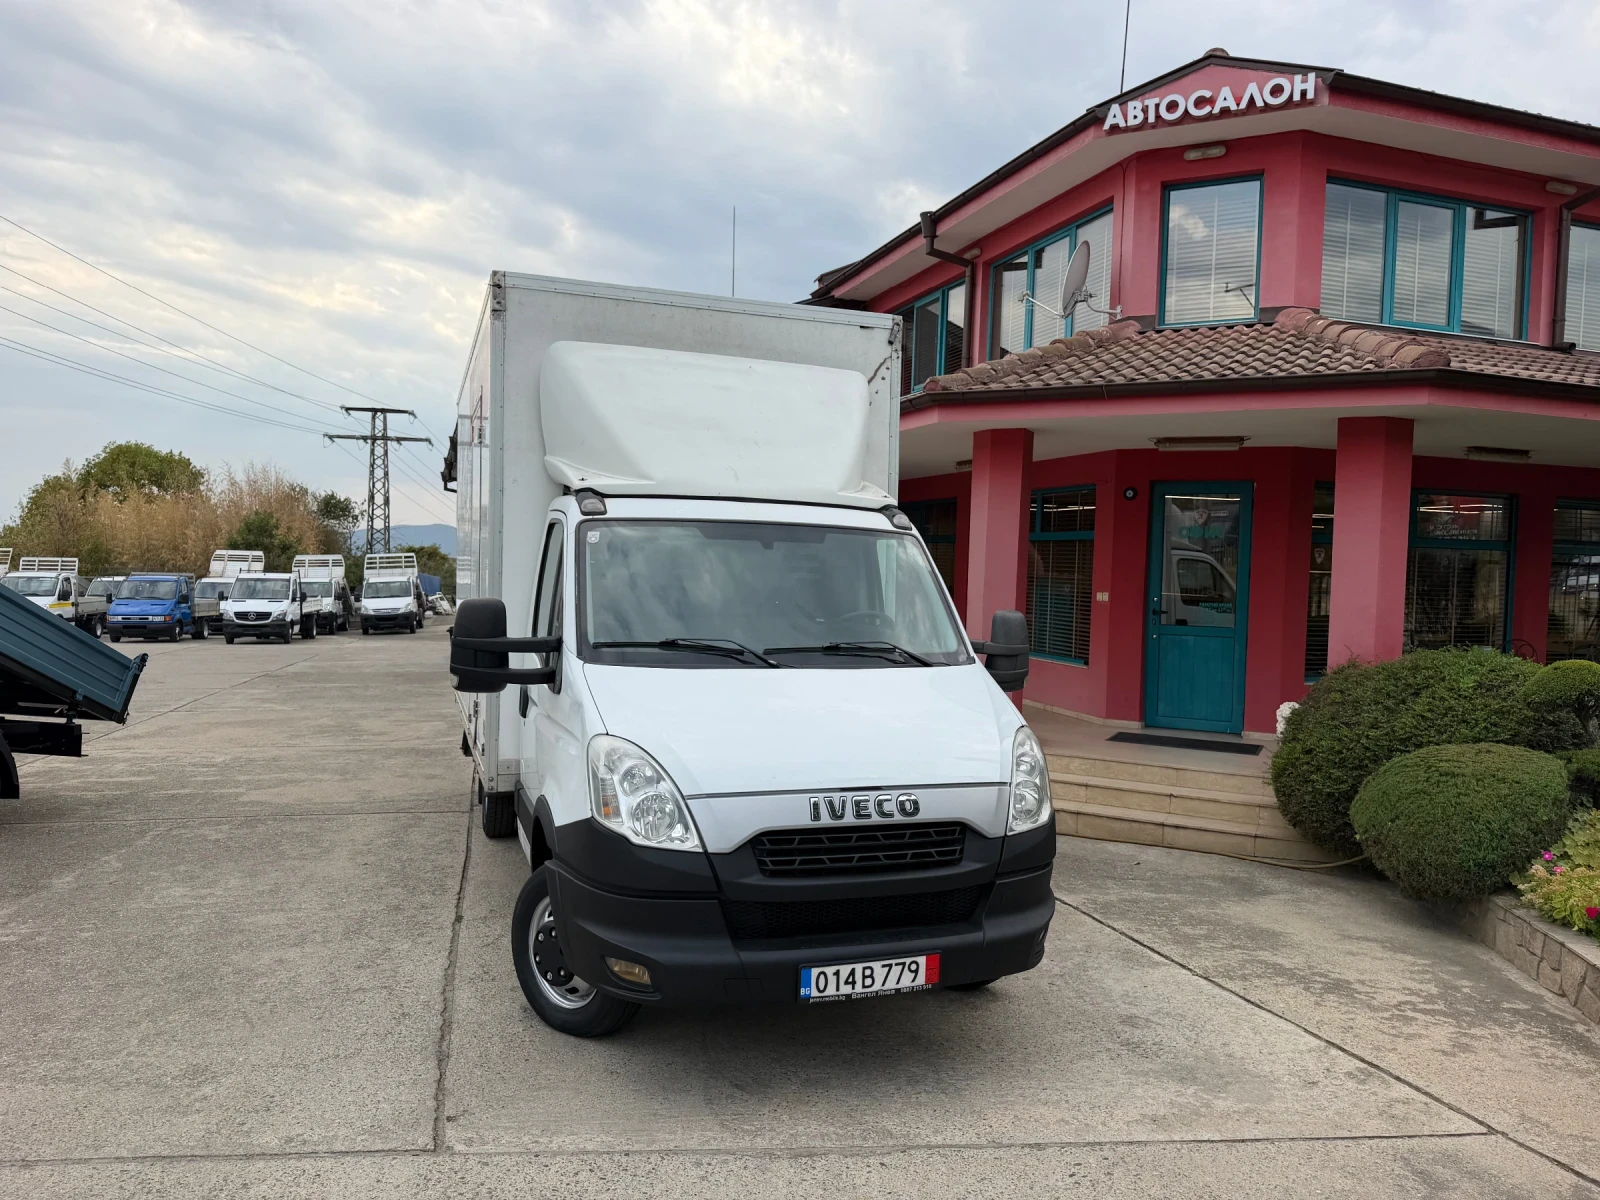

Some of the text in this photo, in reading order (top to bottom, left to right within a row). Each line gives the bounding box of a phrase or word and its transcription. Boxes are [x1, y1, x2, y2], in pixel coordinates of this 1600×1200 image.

[1102, 72, 1316, 132] АВТОСАЛОН
[808, 793, 921, 822] IVECO
[800, 987, 811, 995] BG
[851, 991, 876, 999] Вангел
